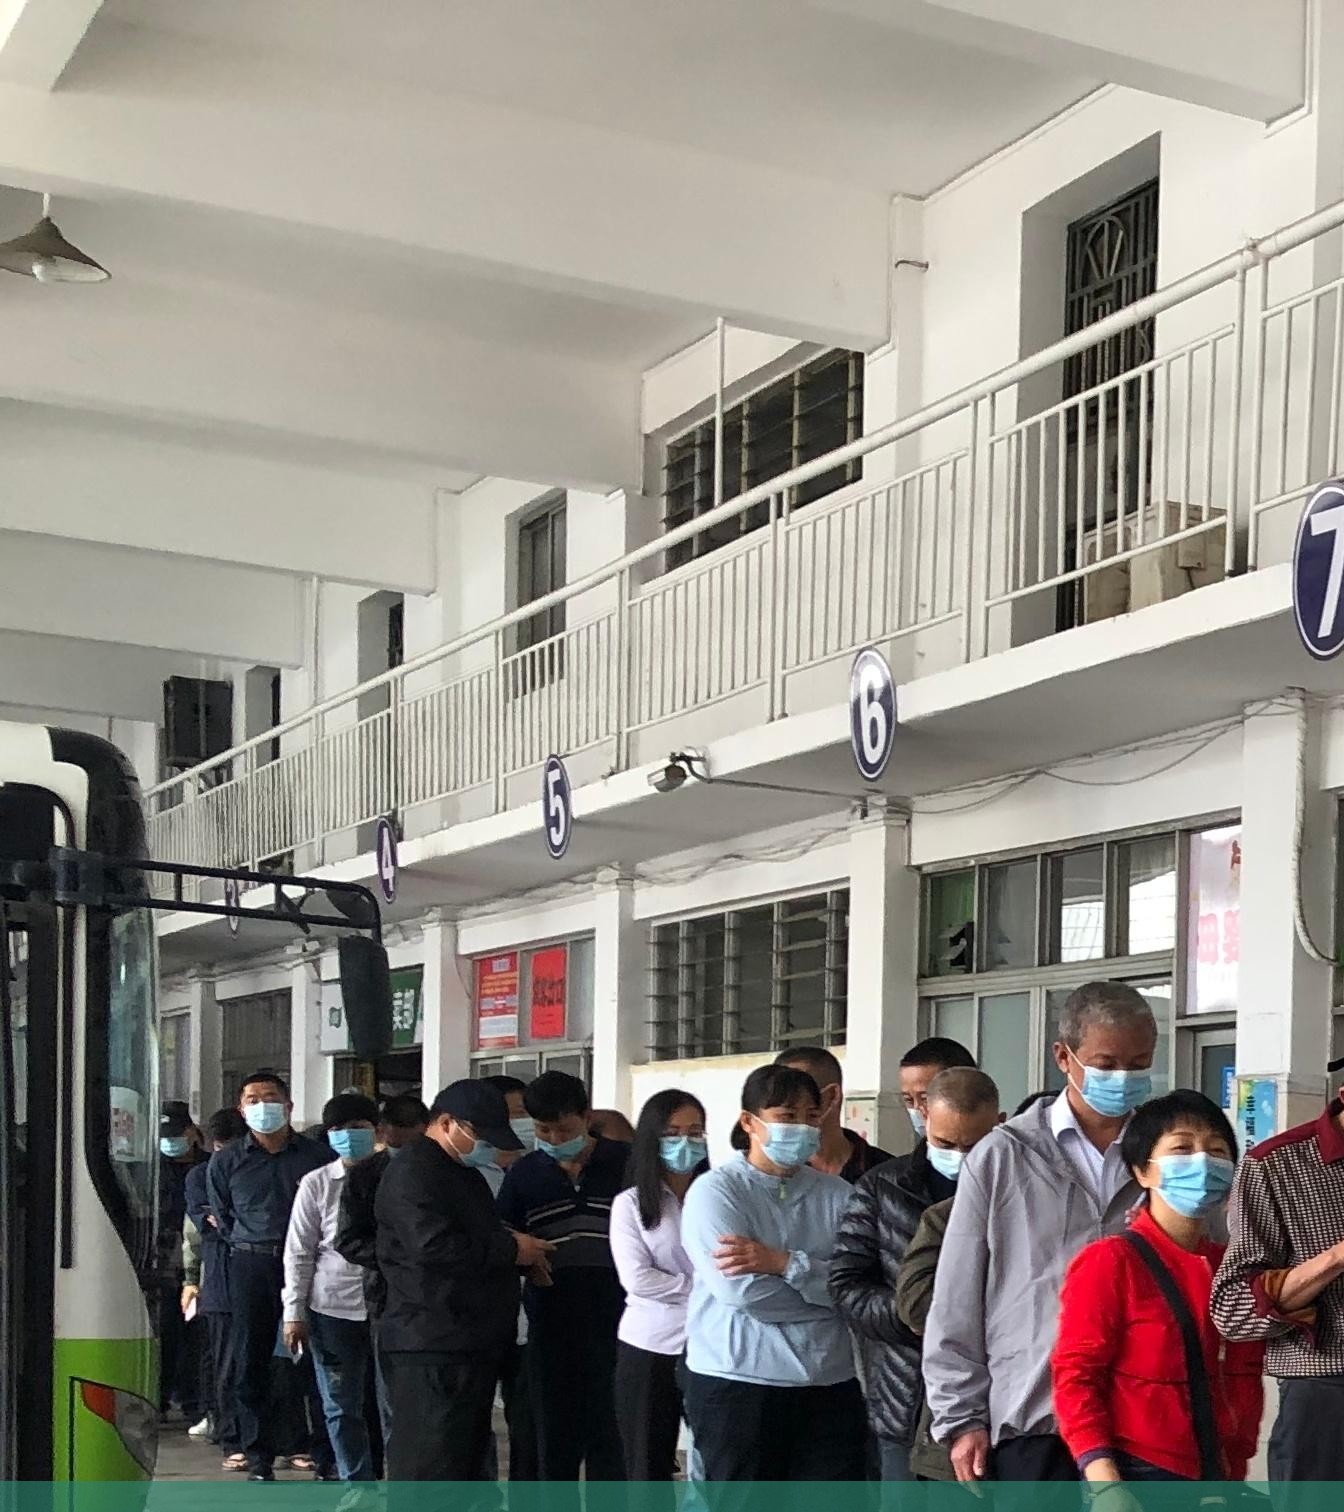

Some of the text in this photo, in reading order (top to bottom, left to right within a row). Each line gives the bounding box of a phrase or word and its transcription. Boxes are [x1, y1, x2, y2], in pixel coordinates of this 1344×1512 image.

[860, 664, 886, 764] 6
[547, 769, 566, 846] 5
[382, 826, 395, 896] 4
